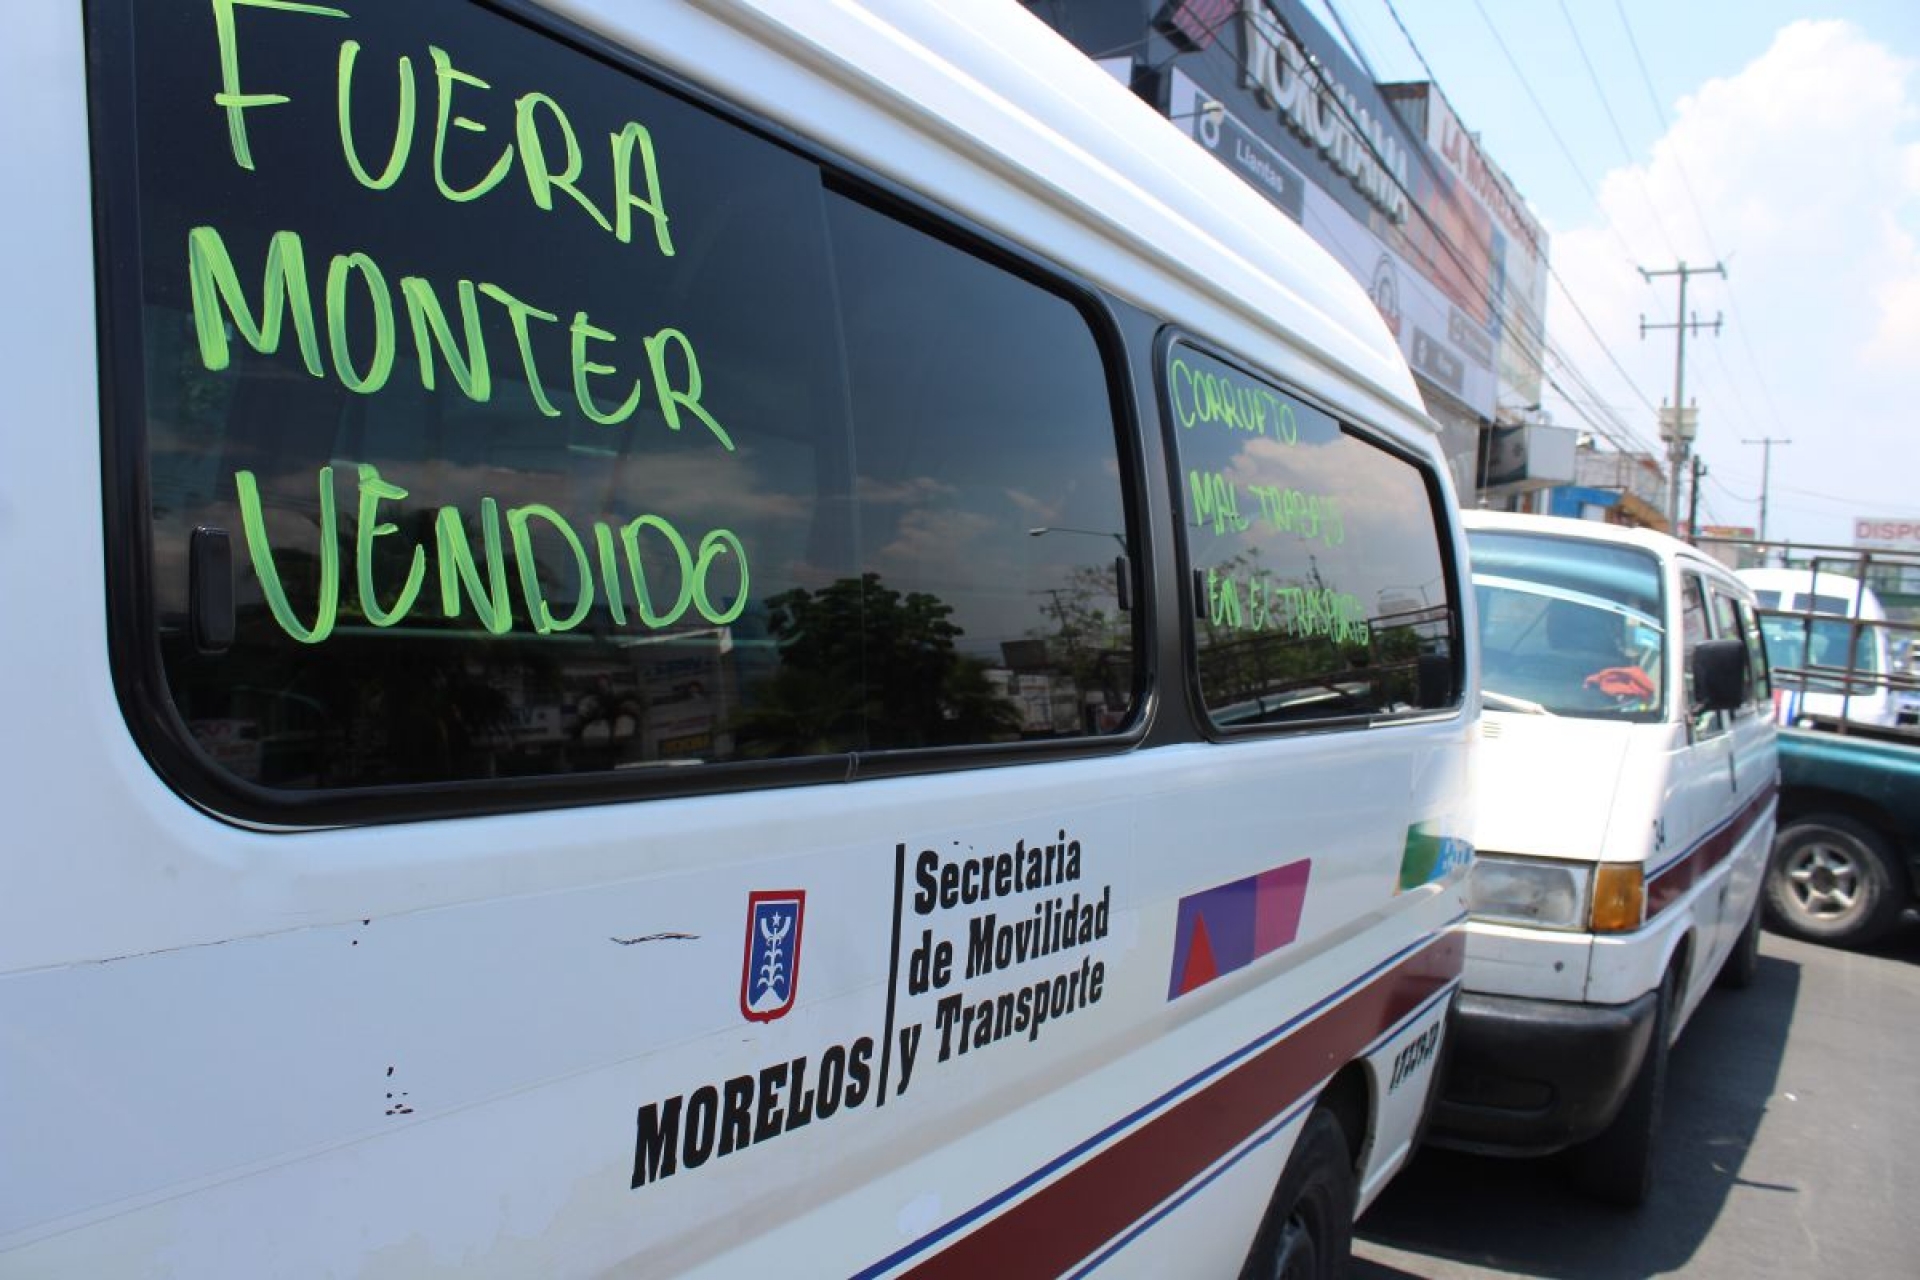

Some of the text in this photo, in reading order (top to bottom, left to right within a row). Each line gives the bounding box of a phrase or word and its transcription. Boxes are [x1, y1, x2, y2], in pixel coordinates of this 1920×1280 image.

[214, 0, 675, 257] FUERA
[188, 226, 735, 451] MONTER
[1171, 359, 1297, 447] CORRUPTO
[236, 464, 750, 644] VENDIDO
[1190, 470, 1249, 536] MAL
[1208, 567, 1242, 628] EN
[1250, 576, 1273, 632] EL
[914, 829, 1082, 917] Secretaria
[908, 885, 1112, 996] de Movilidad
[896, 956, 1106, 1097] y Transporte
[630, 1036, 875, 1190] MORELOS
